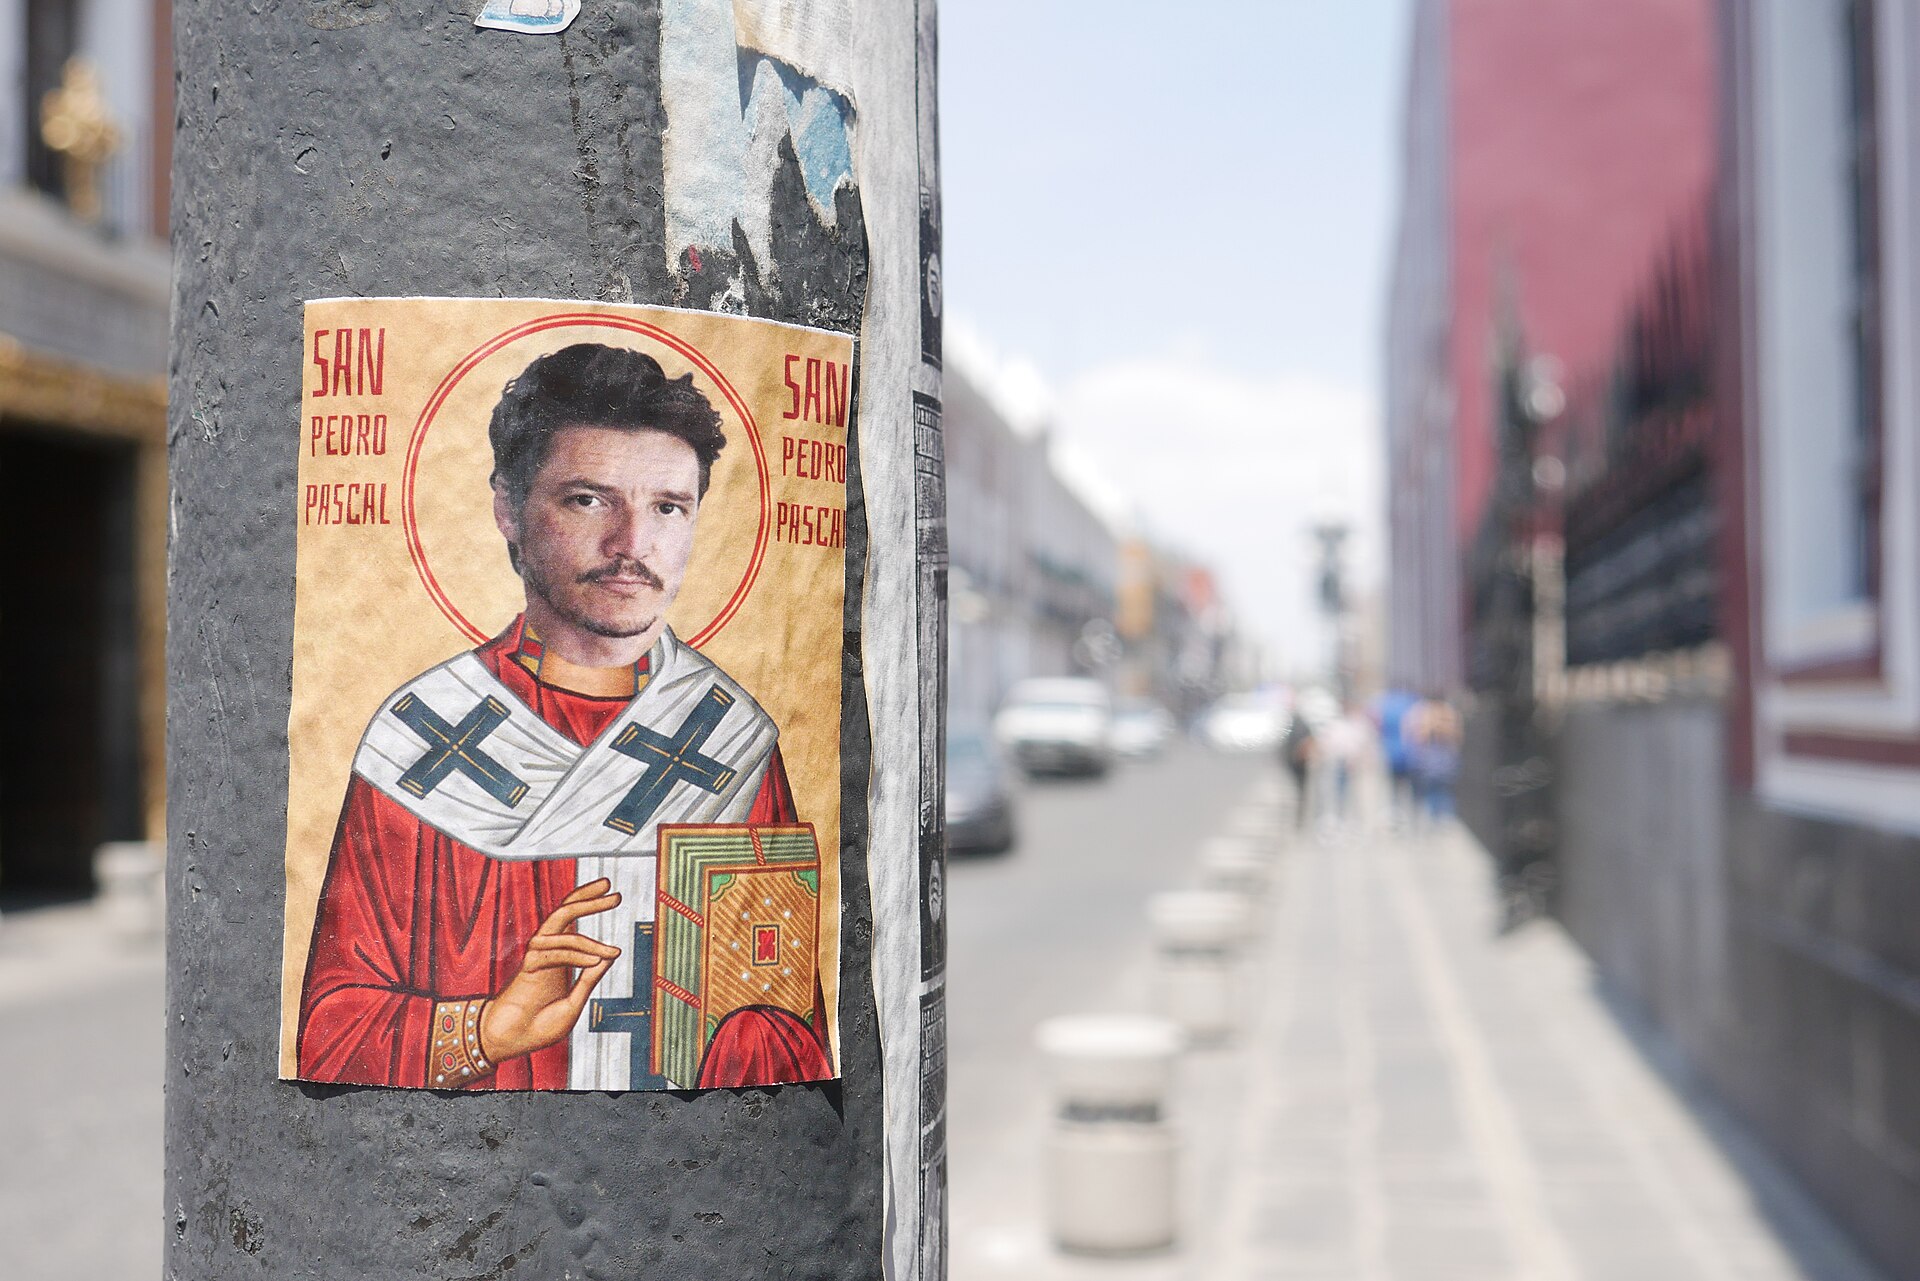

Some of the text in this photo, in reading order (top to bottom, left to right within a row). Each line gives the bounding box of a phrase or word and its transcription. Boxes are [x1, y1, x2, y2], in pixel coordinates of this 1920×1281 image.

[313, 328, 385, 397] SAN
[783, 354, 847, 427] SAN
[312, 414, 387, 457] PEDRO
[783, 437, 846, 484] PEDRO
[306, 483, 390, 525] PASCAL
